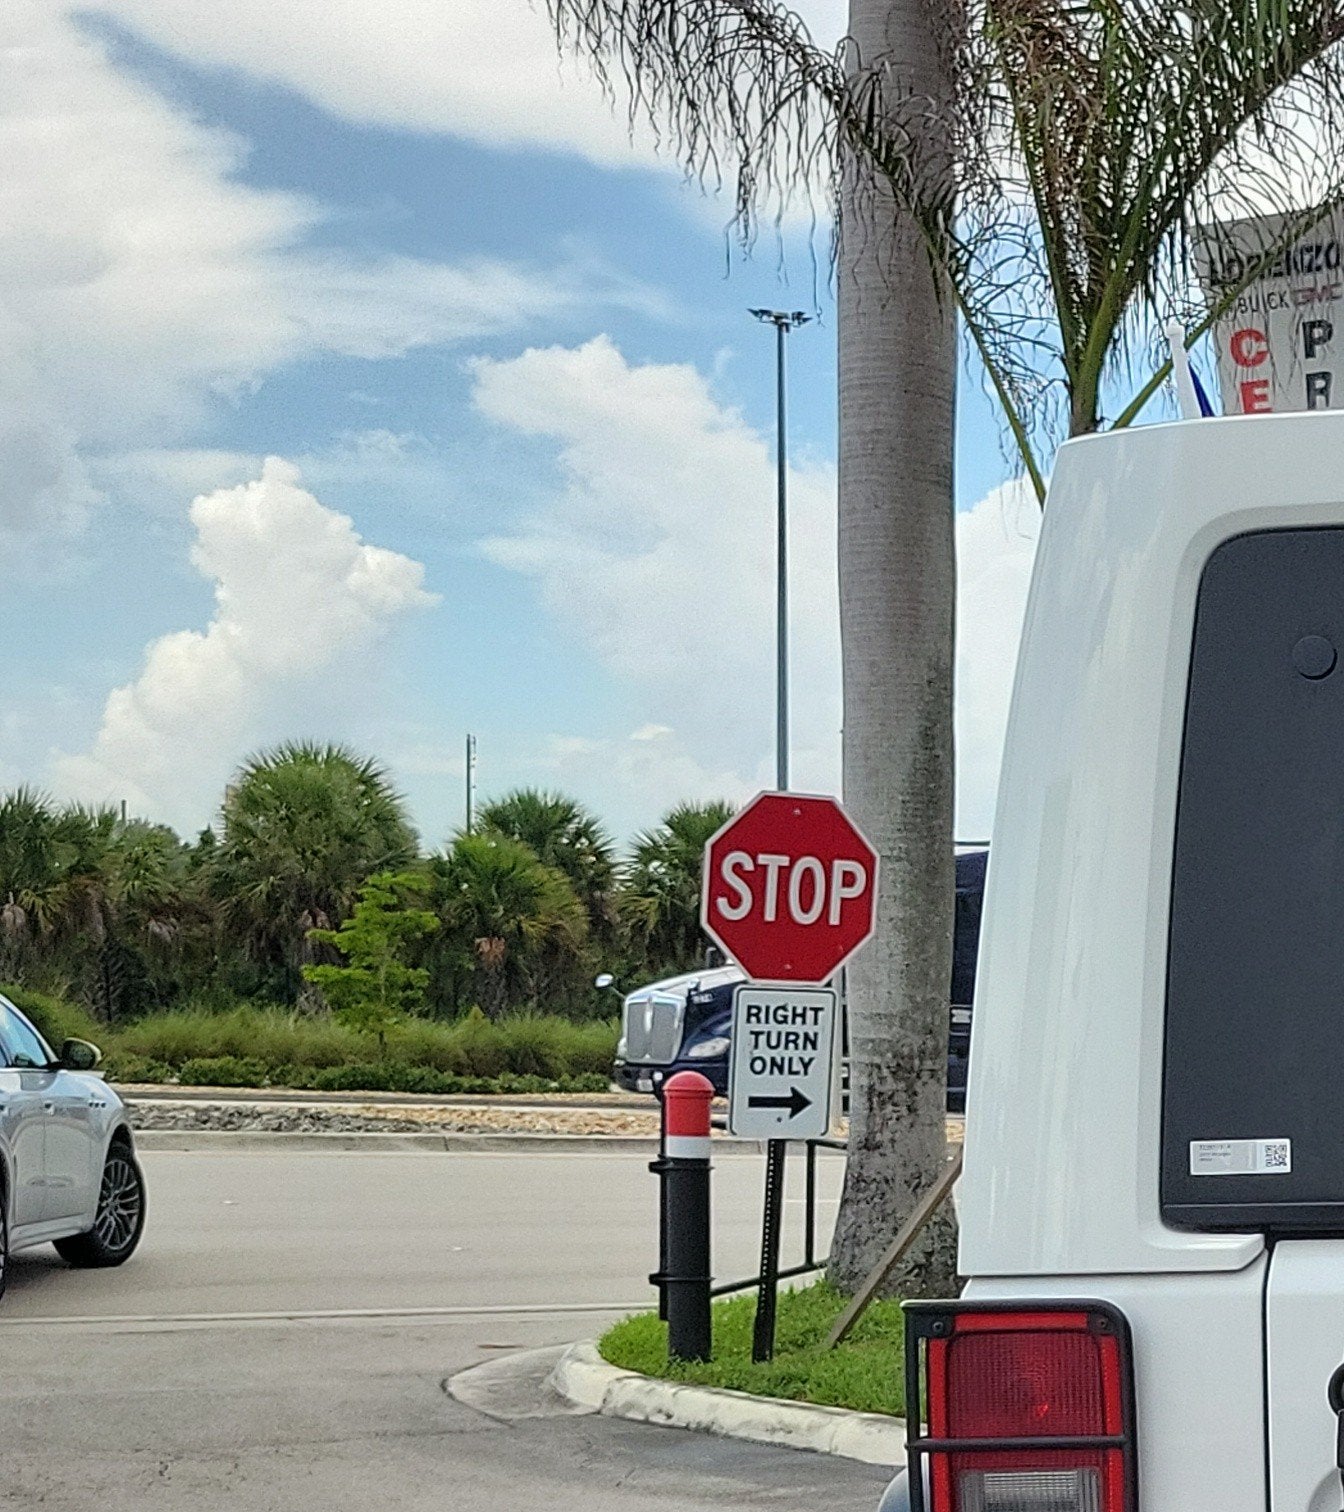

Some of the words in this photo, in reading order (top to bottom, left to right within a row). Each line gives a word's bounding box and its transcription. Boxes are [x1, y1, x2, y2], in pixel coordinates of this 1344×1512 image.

[716, 850, 867, 926] STOP
[745, 1004, 825, 1027] RIGHT
[749, 1030, 818, 1052] TURN
[749, 1056, 815, 1077] ONLY
